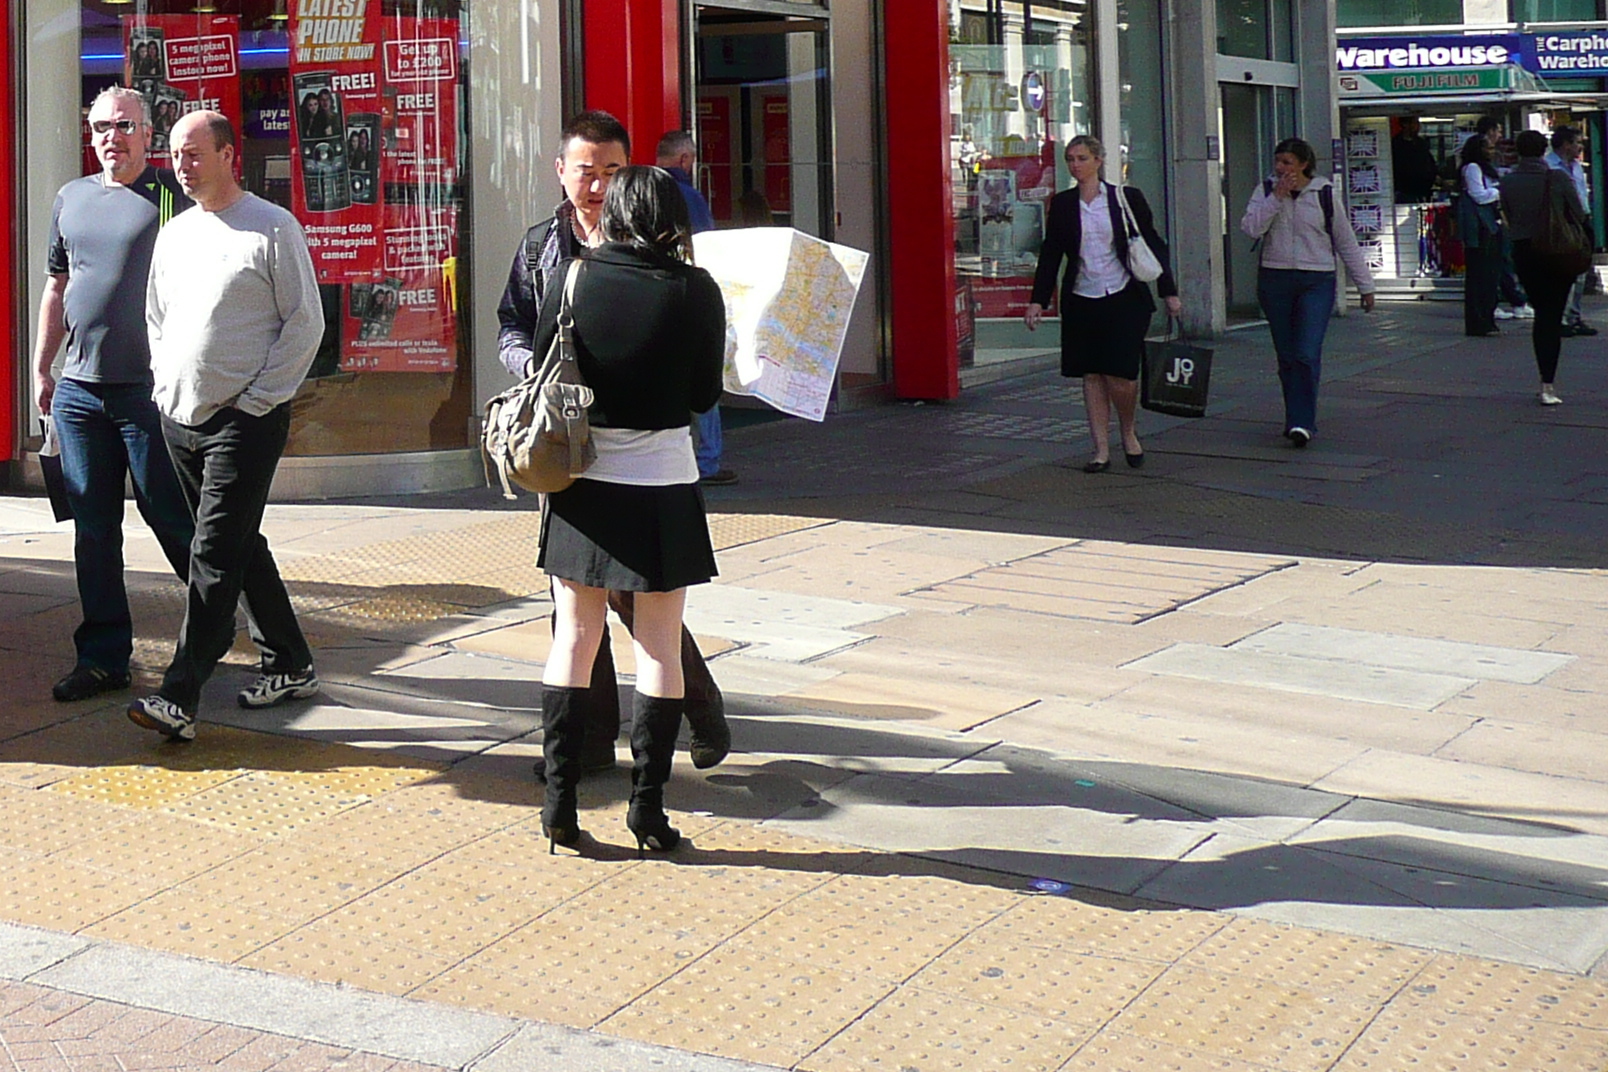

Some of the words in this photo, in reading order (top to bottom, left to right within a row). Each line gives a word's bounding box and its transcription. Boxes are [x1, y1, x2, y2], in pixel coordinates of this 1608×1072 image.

[298, 18, 364, 45] PHONE
[172, 45, 178, 55] 5
[1546, 34, 1608, 54] Carph
[203, 52, 231, 65] phone
[298, 47, 312, 62] IN
[313, 46, 345, 62] STORE
[346, 45, 375, 60] NOW!
[332, 73, 375, 92] FREE!
[183, 98, 221, 116] FREE
[397, 93, 435, 110] FREE
[260, 109, 278, 120] pay
[304, 224, 347, 235] Samsung
[348, 223, 373, 233] G600
[323, 237, 329, 247] 5
[331, 236, 377, 248] megapixel
[321, 249, 357, 260] camera!
[399, 289, 436, 306] FREE
